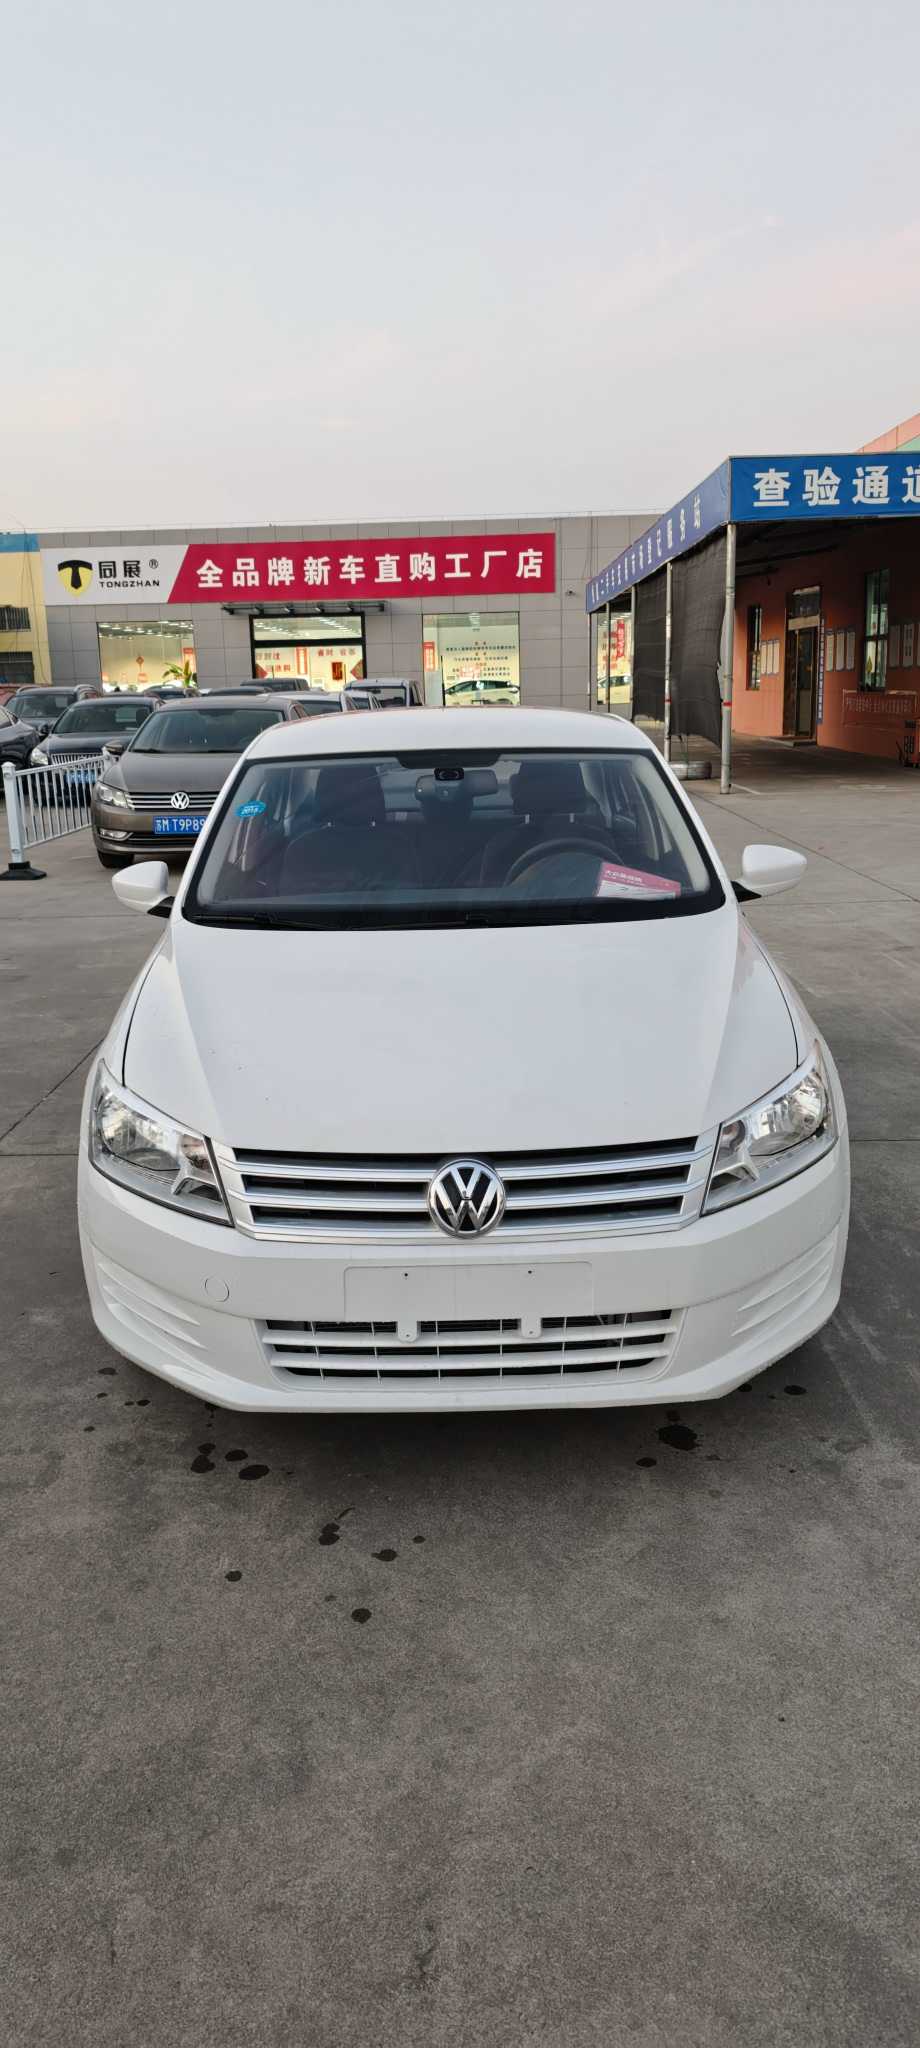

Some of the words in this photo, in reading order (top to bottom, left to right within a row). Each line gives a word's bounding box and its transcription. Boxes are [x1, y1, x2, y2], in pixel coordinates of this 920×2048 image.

[99, 560, 140, 579] 同展
[196, 548, 543, 588] 全品牌新车直购工厂店
[99, 579, 160, 588] TONGZHAN
